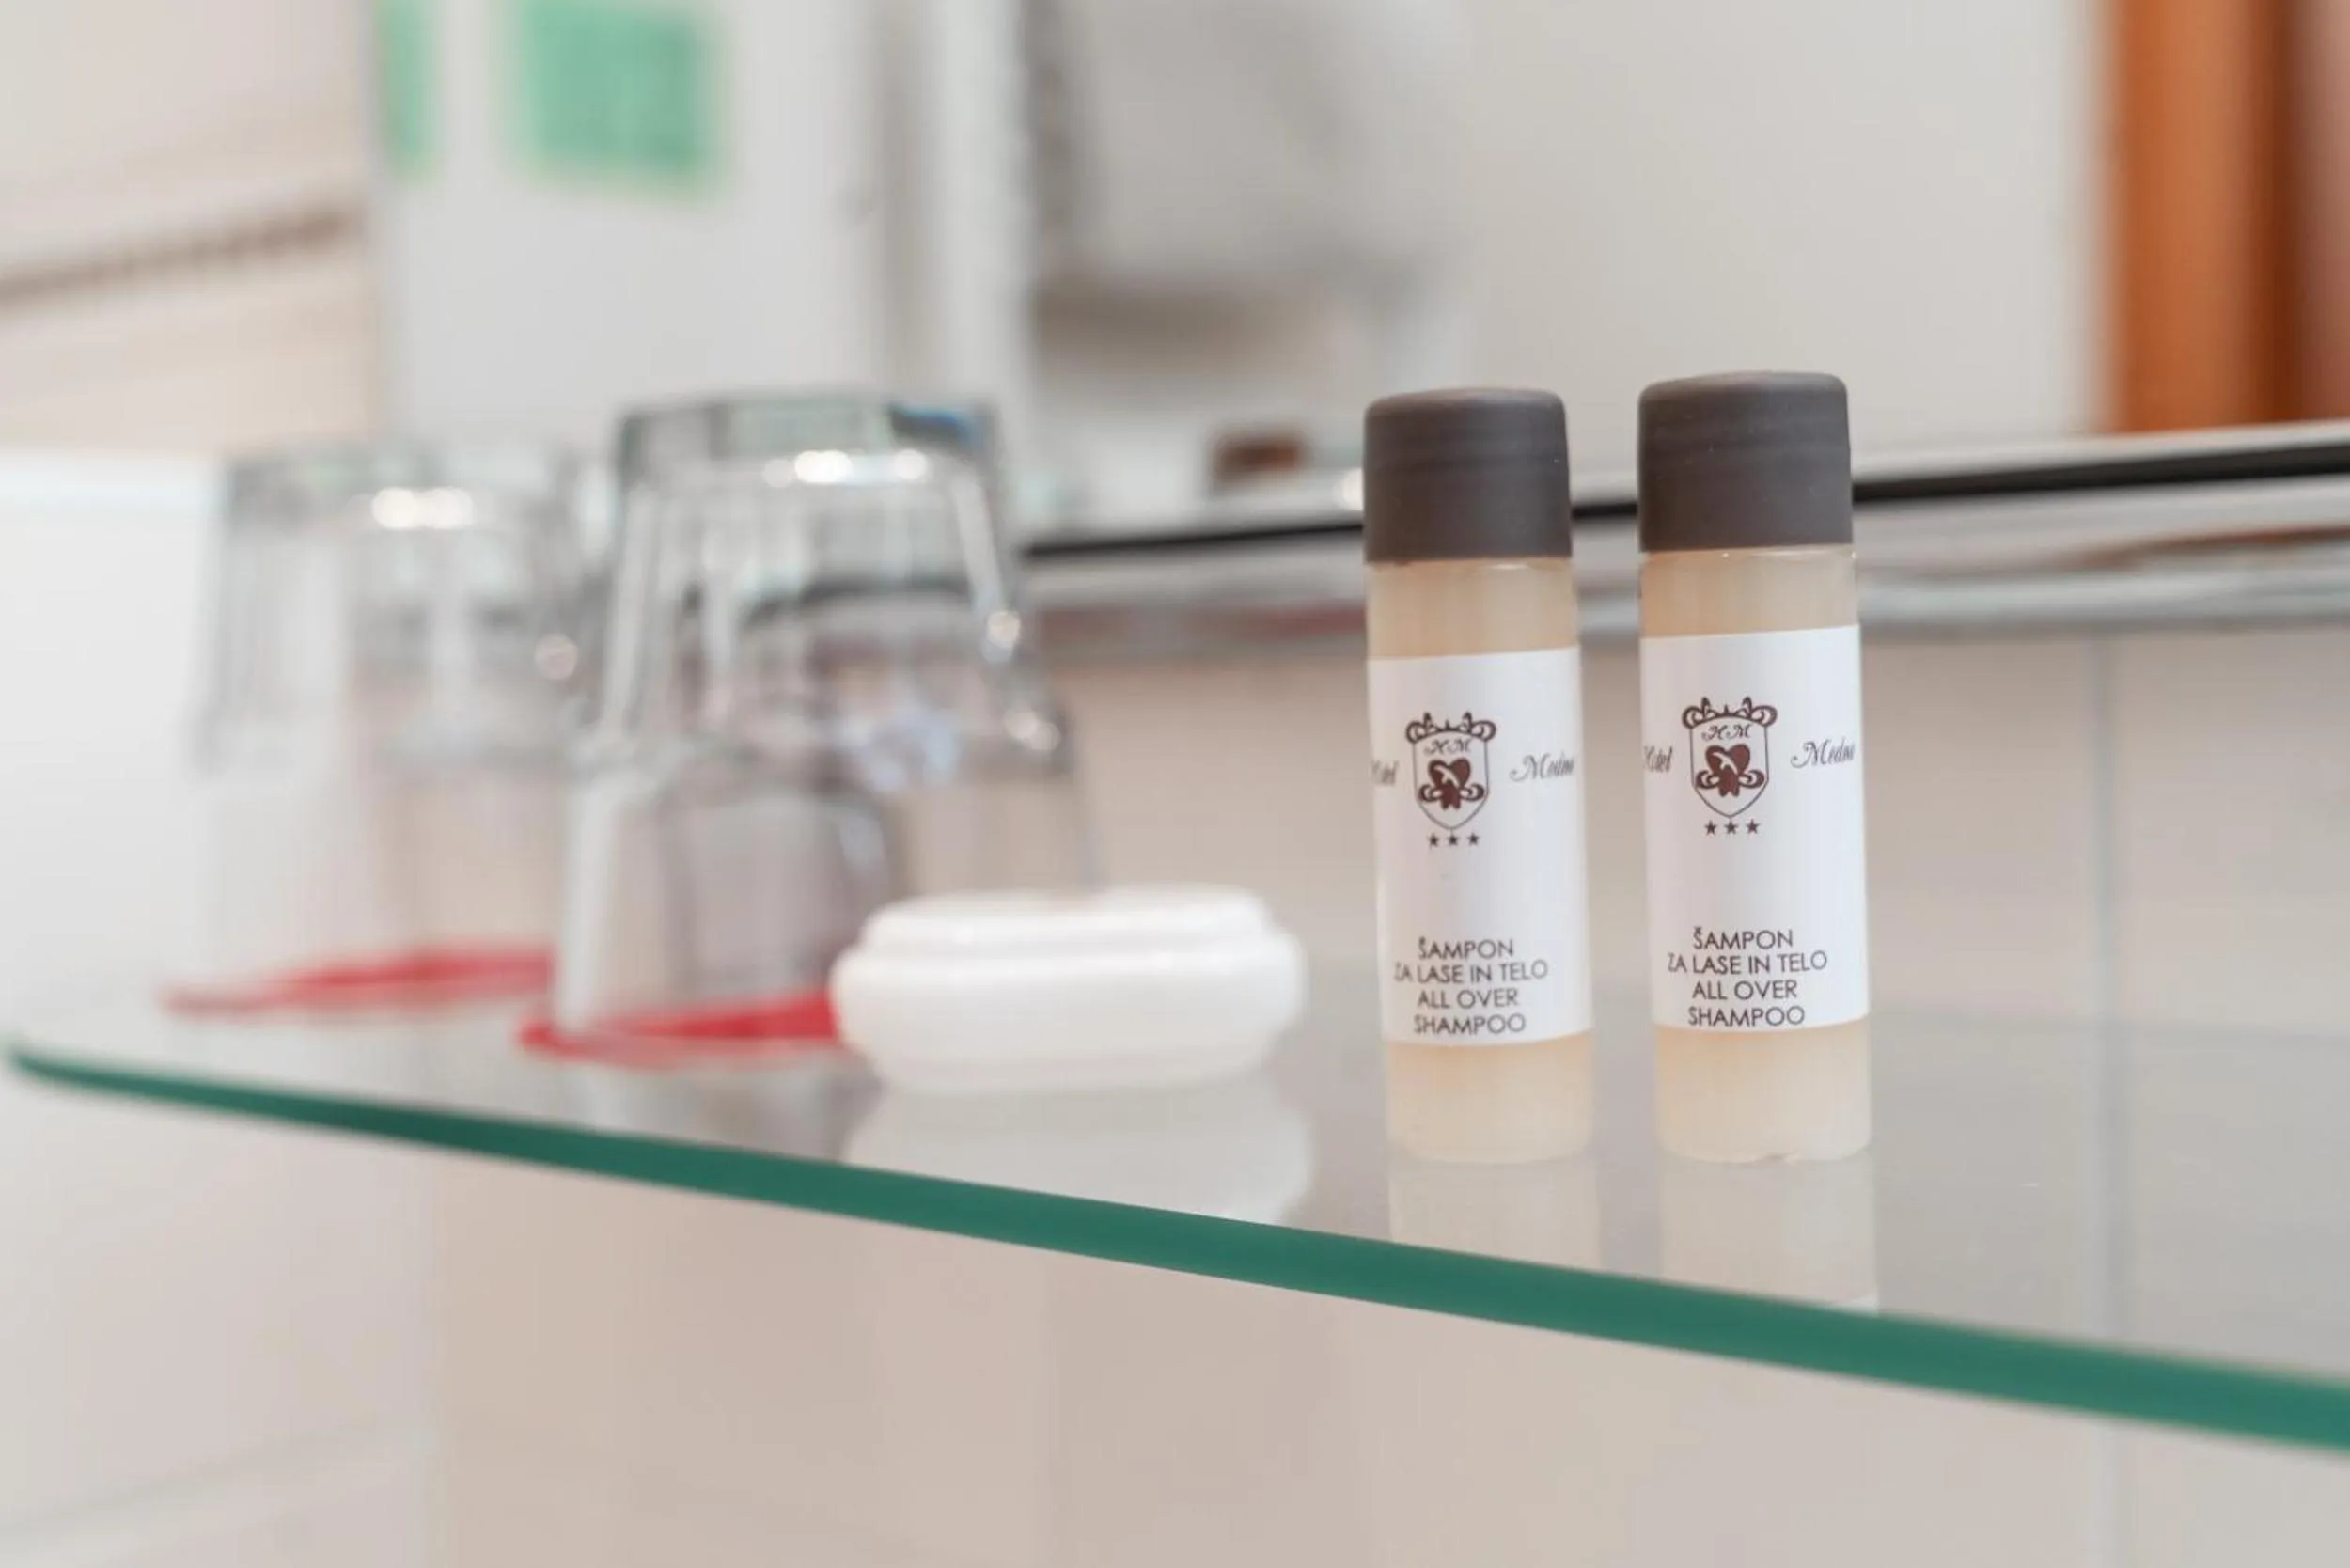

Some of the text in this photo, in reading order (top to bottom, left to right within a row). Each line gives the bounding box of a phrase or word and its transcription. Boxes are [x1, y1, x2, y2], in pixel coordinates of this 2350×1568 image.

[1418, 936, 1514, 960] ŠAMPON
[1693, 926, 1794, 949] ŠAMPON
[1417, 964, 1464, 984] LASE
[1470, 964, 1493, 983] IN
[1498, 959, 1549, 981] TELO
[1667, 950, 1827, 975] ZA LASE IN TELO
[1418, 987, 1519, 1009] ALL OVER
[1692, 980, 1798, 1000] ALL OVER
[1413, 1012, 1526, 1035] SHAMPOO
[1688, 1005, 1805, 1027] SHAMPOO
